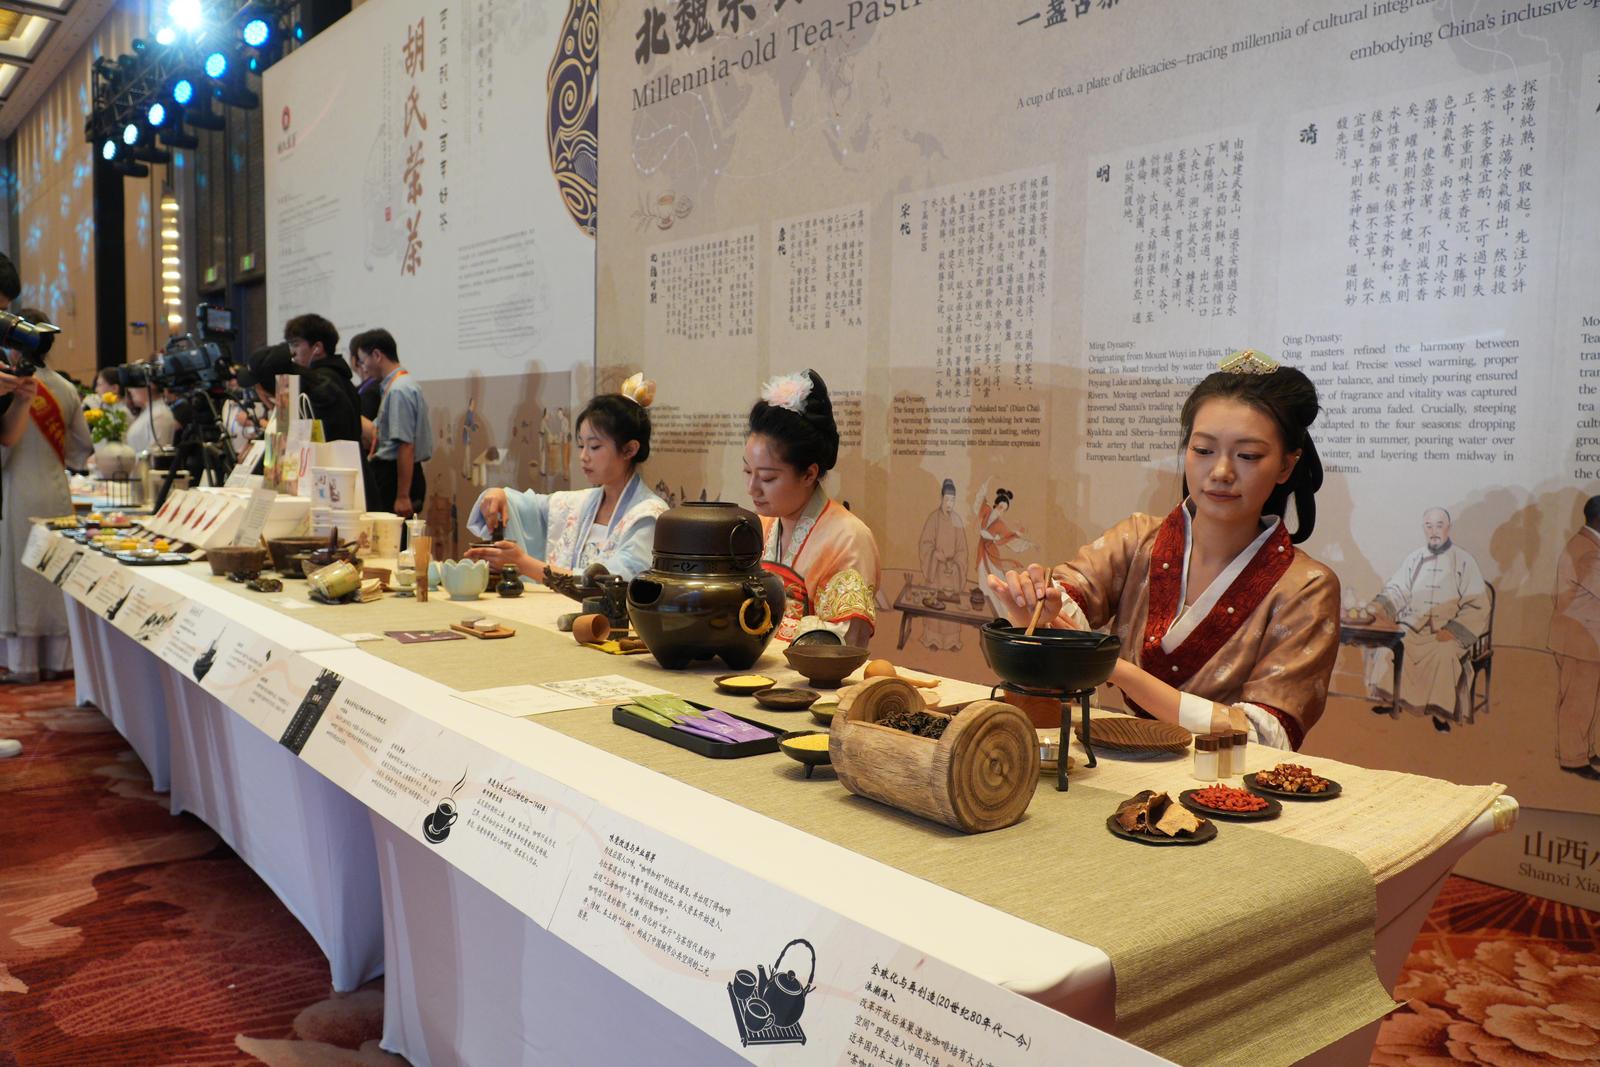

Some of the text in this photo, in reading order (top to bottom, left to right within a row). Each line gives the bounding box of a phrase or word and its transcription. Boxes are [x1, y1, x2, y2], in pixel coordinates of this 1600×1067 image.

[1349, 0, 1577, 61] embodying China's inclusive
[1017, 98, 1025, 110] A
[1026, 94, 1043, 108] cup
[1046, 88, 1056, 101] of
[1057, 86, 1074, 98] tea,
[1077, 84, 1083, 93] a
[1086, 76, 1110, 94] plate
[1113, 68, 1125, 84] of
[1231, 27, 1292, 54] millennia
[1295, 18, 1311, 37] of
[1312, 4, 1368, 33] cultural
[632, 33, 776, 111] Millennia-old
[1300, 123, 1318, 145] 清
[1097, 164, 1110, 183] 明
[1089, 340, 1135, 350] Ming Dynasty:
[1283, 334, 1343, 345] Qing Dynasty:
[1089, 353, 1125, 363] Originating
[1127, 353, 1143, 361] from
[1145, 352, 1167, 360] Mount
[1169, 350, 1187, 360] Wuyi
[1189, 350, 1197, 358] in
[1199, 349, 1222, 359] Fujian,
[1282, 338, 1519, 360] Qing masters refined the harmony between
[1310, 362, 1326, 372] and
[1332, 361, 1349, 371] leaf.
[1357, 359, 1388, 370] Precise
[1394, 358, 1422, 368] vessel
[1428, 355, 1477, 368] warming,
[1484, 355, 1519, 366] proper
[1337, 370, 1518, 386] balance, and timely pouring ensured
[1329, 390, 1337, 400] of
[1340, 390, 1383, 402] fragrance
[1386, 389, 1404, 399] and
[1409, 387, 1442, 399] vitality
[1447, 388, 1467, 398] was
[1471, 386, 1517, 399] captured
[1578, 384, 1597, 394] the
[1325, 403, 1516, 416] peak aroma faded. Crucially, steeping
[1578, 402, 1595, 411] tea
[1320, 419, 1516, 432] adapted to the four seasons: dropping
[1327, 436, 1351, 444] water
[1356, 434, 1365, 444] in
[1370, 436, 1410, 446] summer,
[1415, 435, 1454, 447] pouring
[1459, 435, 1487, 445] water
[1492, 436, 1514, 445] over
[1322, 449, 1514, 463] winter, and layering them midway in
[1324, 464, 1361, 474] autumn.
[1575, 469, 1592, 479] the
[1519, 862, 1570, 887] Shanxi
